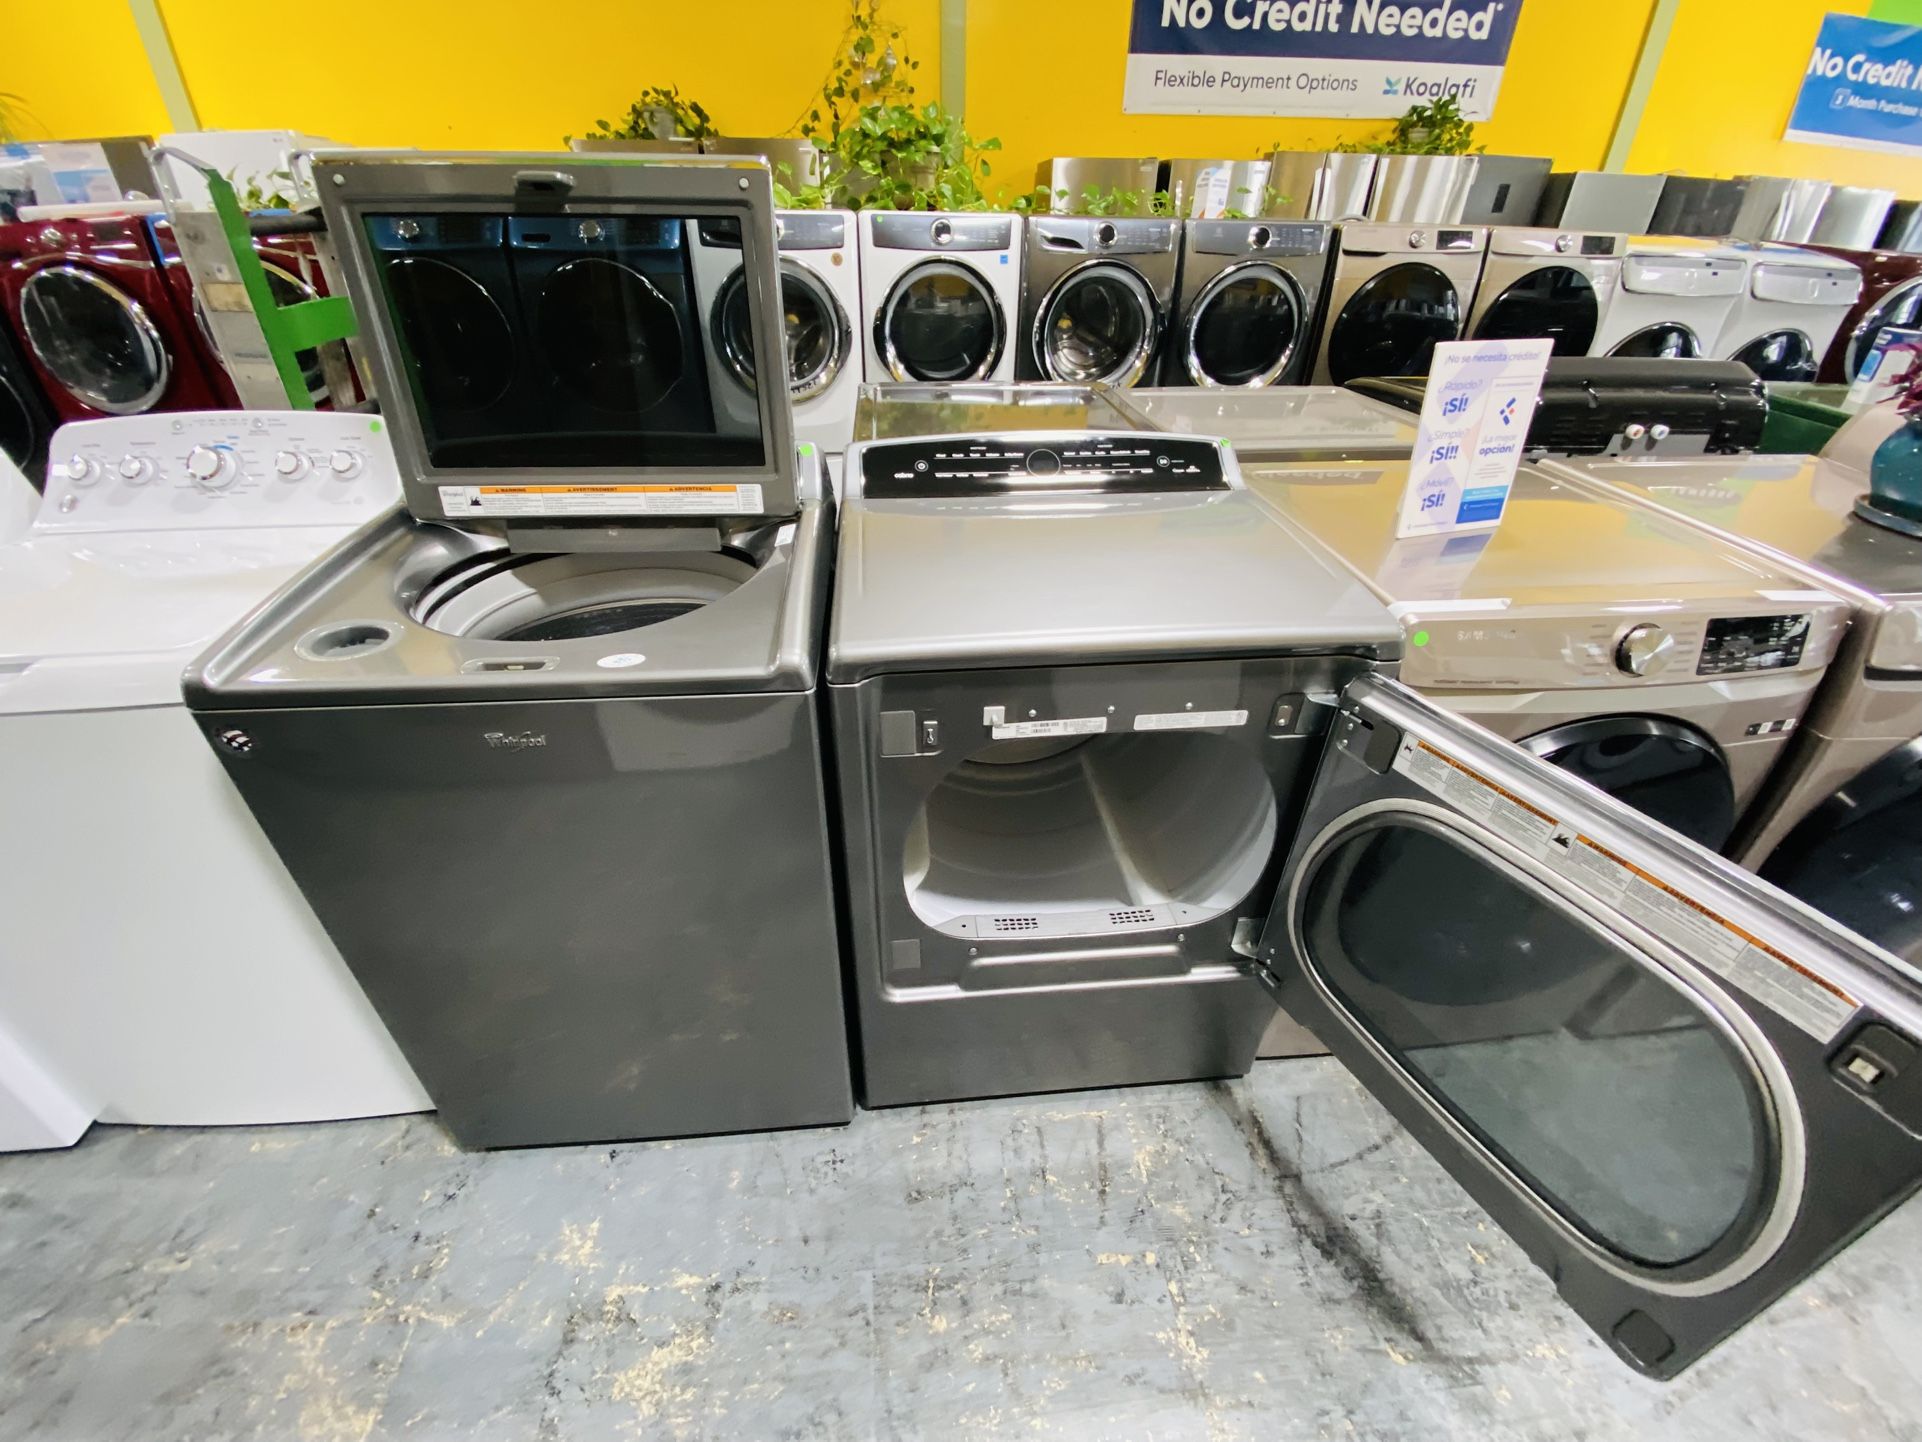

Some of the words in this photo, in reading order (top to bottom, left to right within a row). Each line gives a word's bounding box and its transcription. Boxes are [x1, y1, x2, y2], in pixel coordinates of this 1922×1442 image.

[1161, 0, 1213, 29] No
[1224, 0, 1343, 33] Credit
[1806, 46, 1844, 78] No
[1846, 53, 1914, 89] Credit
[1154, 69, 1216, 88] Flexible
[1221, 71, 1292, 93] Payment
[1296, 73, 1358, 95] Options
[1403, 76, 1477, 98] Koalafi
[1472, 352, 1507, 362] necesita
[1442, 393, 1469, 417] ¡SÍ!
[1479, 443, 1516, 457] opción!
[1421, 490, 1446, 512] ¡SÍ!
[484, 731, 547, 752] Whirlpool
